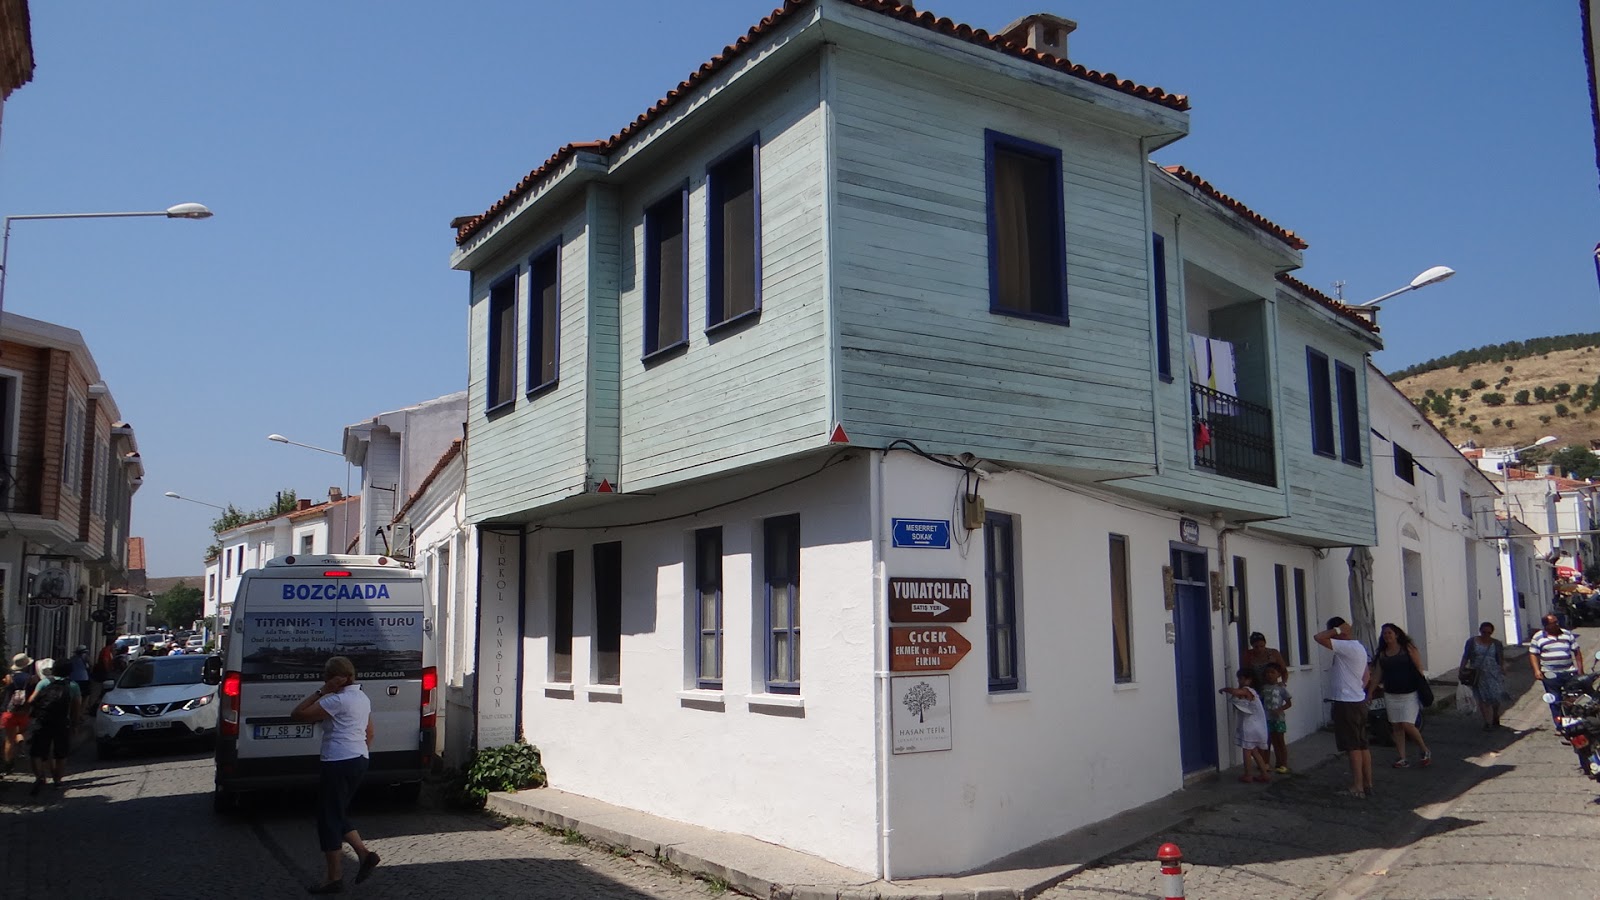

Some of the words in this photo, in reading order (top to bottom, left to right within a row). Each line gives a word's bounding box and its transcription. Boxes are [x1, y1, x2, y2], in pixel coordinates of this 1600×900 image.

[905, 524, 938, 532] MESERRET
[911, 533, 933, 541] SOKAK
[282, 584, 390, 600] BOZCAADA
[330, 617, 375, 627] TEKNE
[378, 617, 415, 627] TURU
[895, 646, 920, 655] EKMEK
[261, 727, 272, 736] 17
[278, 726, 289, 735] SB
[296, 725, 312, 734] 975
[899, 728, 924, 736] HASAN
